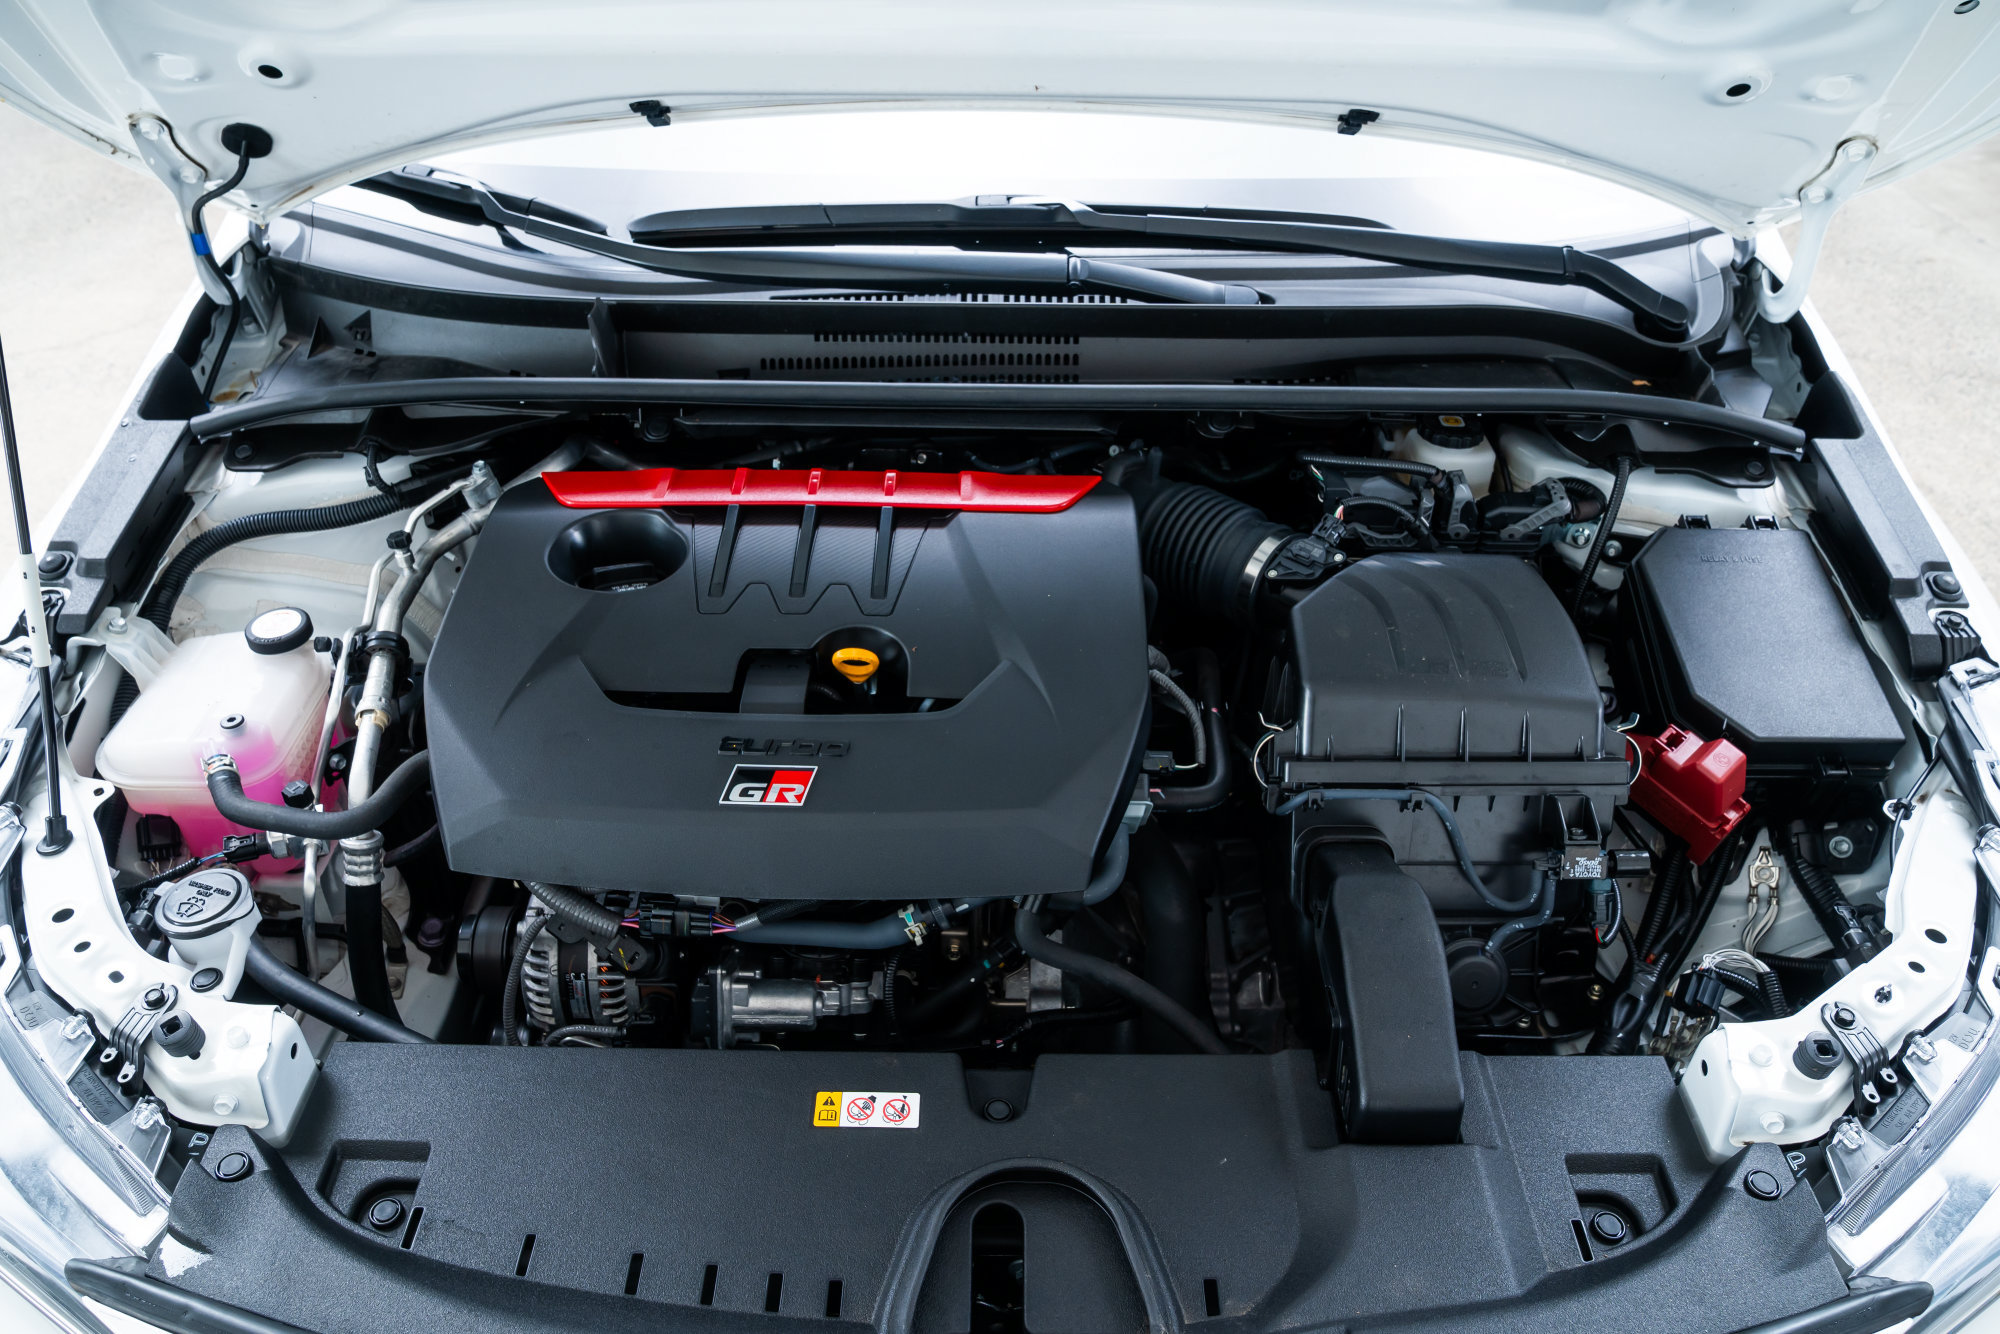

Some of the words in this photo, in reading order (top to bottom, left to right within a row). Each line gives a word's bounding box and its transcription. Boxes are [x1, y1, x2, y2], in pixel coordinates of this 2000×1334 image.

[728, 782, 805, 803] GR
[188, 880, 214, 892] WASHER
[213, 887, 232, 897] FLUID
[196, 889, 213, 898] ONLY
